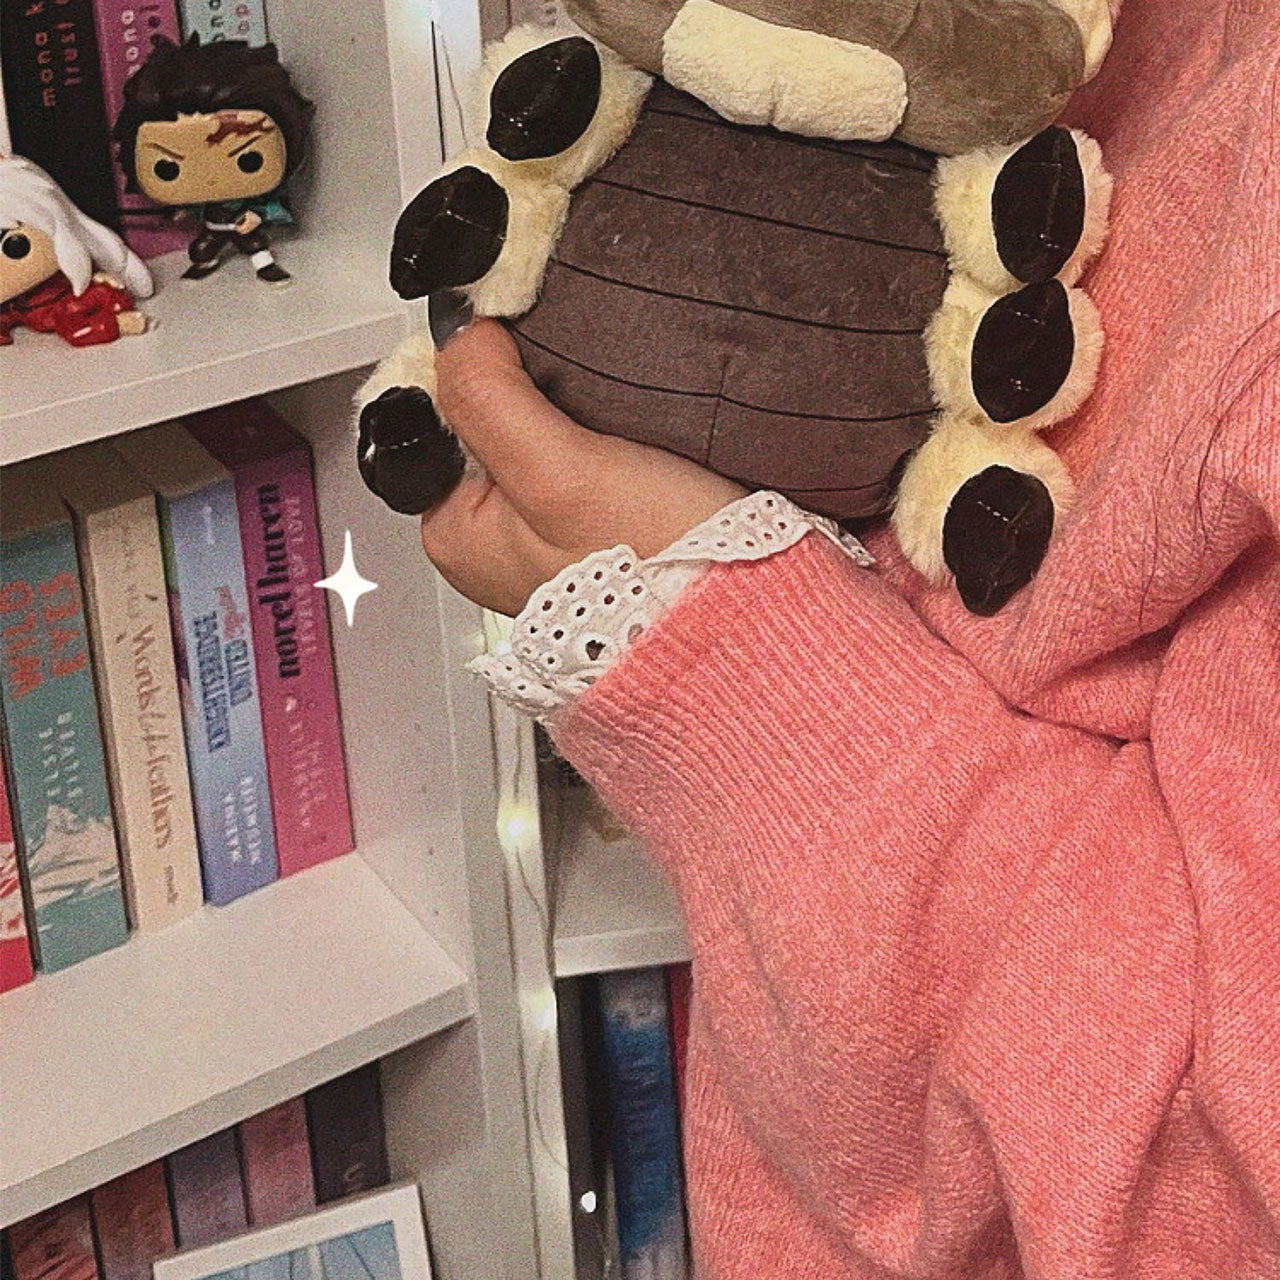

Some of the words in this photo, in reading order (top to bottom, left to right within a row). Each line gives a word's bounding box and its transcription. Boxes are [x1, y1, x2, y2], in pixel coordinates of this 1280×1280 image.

[34, 31, 57, 107] mona
[0, 579, 44, 701] WILD
[37, 570, 87, 677] EYES
[38, 726, 61, 799] ELSIE
